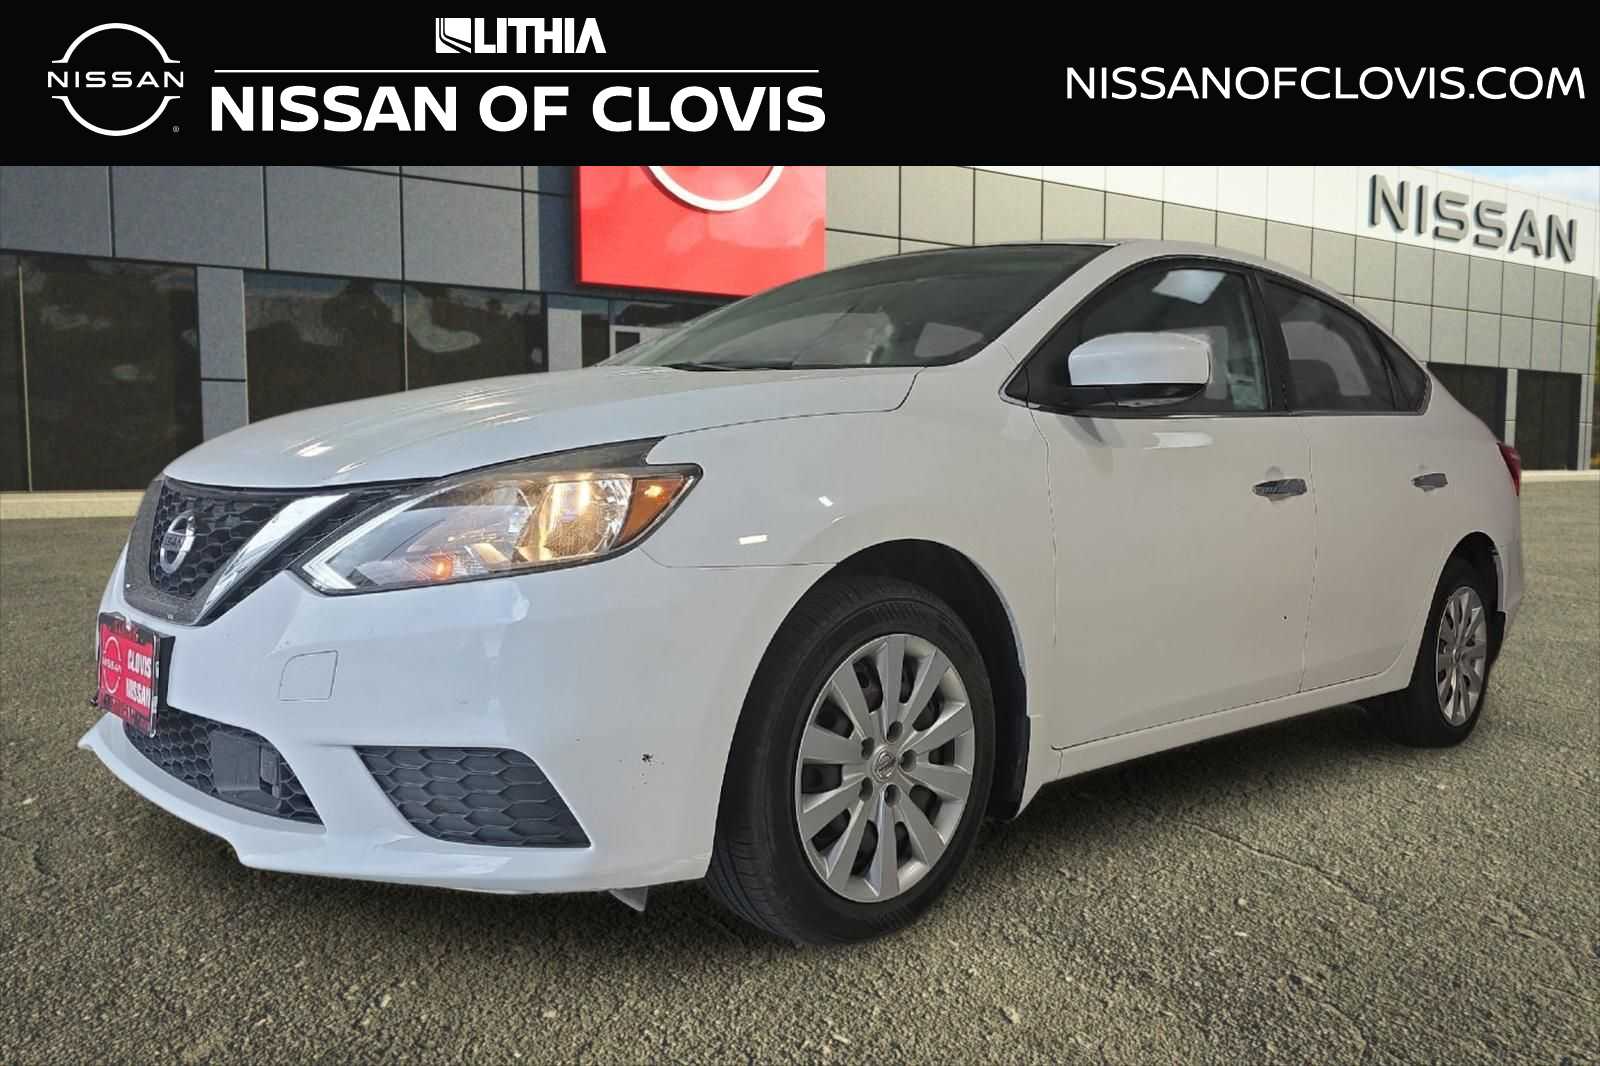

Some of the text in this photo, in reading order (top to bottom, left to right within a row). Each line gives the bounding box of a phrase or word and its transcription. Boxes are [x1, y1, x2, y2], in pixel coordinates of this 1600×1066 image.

[1369, 174, 1577, 262] NISSAN
[127, 649, 152, 678] CLOVIS
[126, 678, 152, 709] NISSAN
